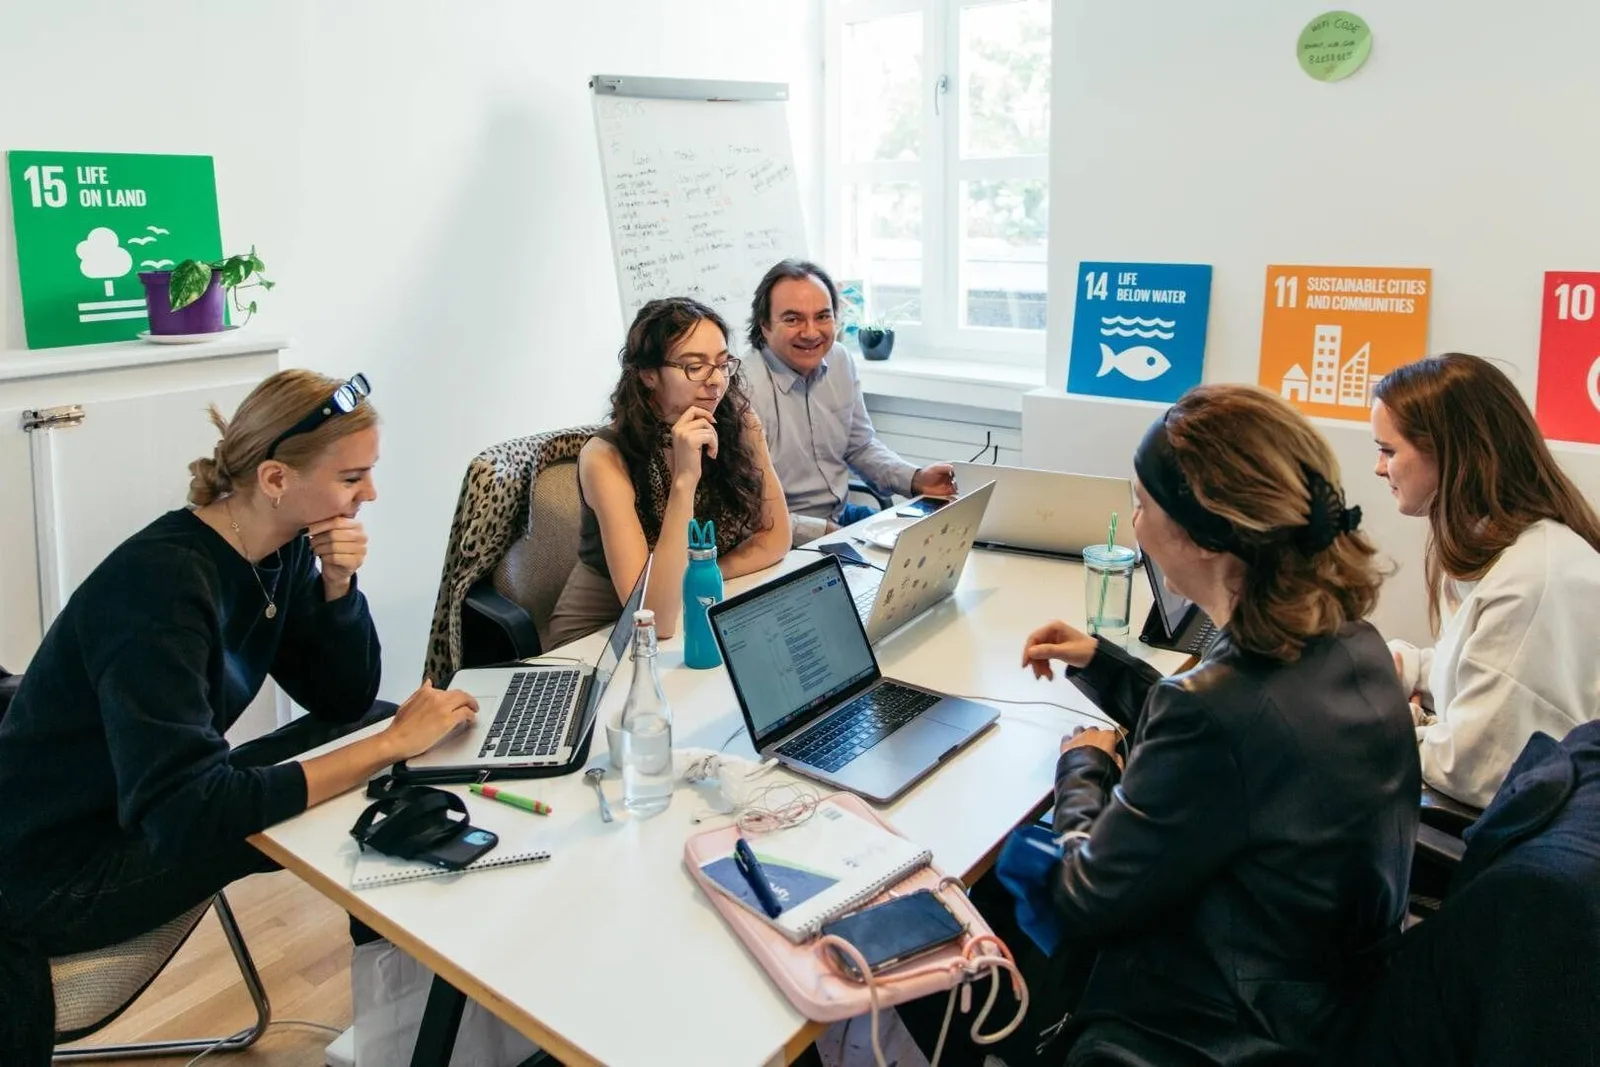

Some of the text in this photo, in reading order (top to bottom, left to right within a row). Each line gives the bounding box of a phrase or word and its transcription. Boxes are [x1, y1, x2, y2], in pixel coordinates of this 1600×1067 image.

[77, 166, 109, 185] LIFE
[23, 165, 68, 208] 15
[80, 189, 147, 207] ON LAND
[1085, 271, 1108, 300] 14
[1118, 272, 1138, 286] LIFE
[1306, 276, 1426, 296] SUSTAINABLE CITIES
[1116, 288, 1186, 304] BELOW WATER
[1274, 276, 1298, 308] 11
[1306, 295, 1415, 314] AND COMMUNITIES
[1554, 283, 1595, 321] 10
